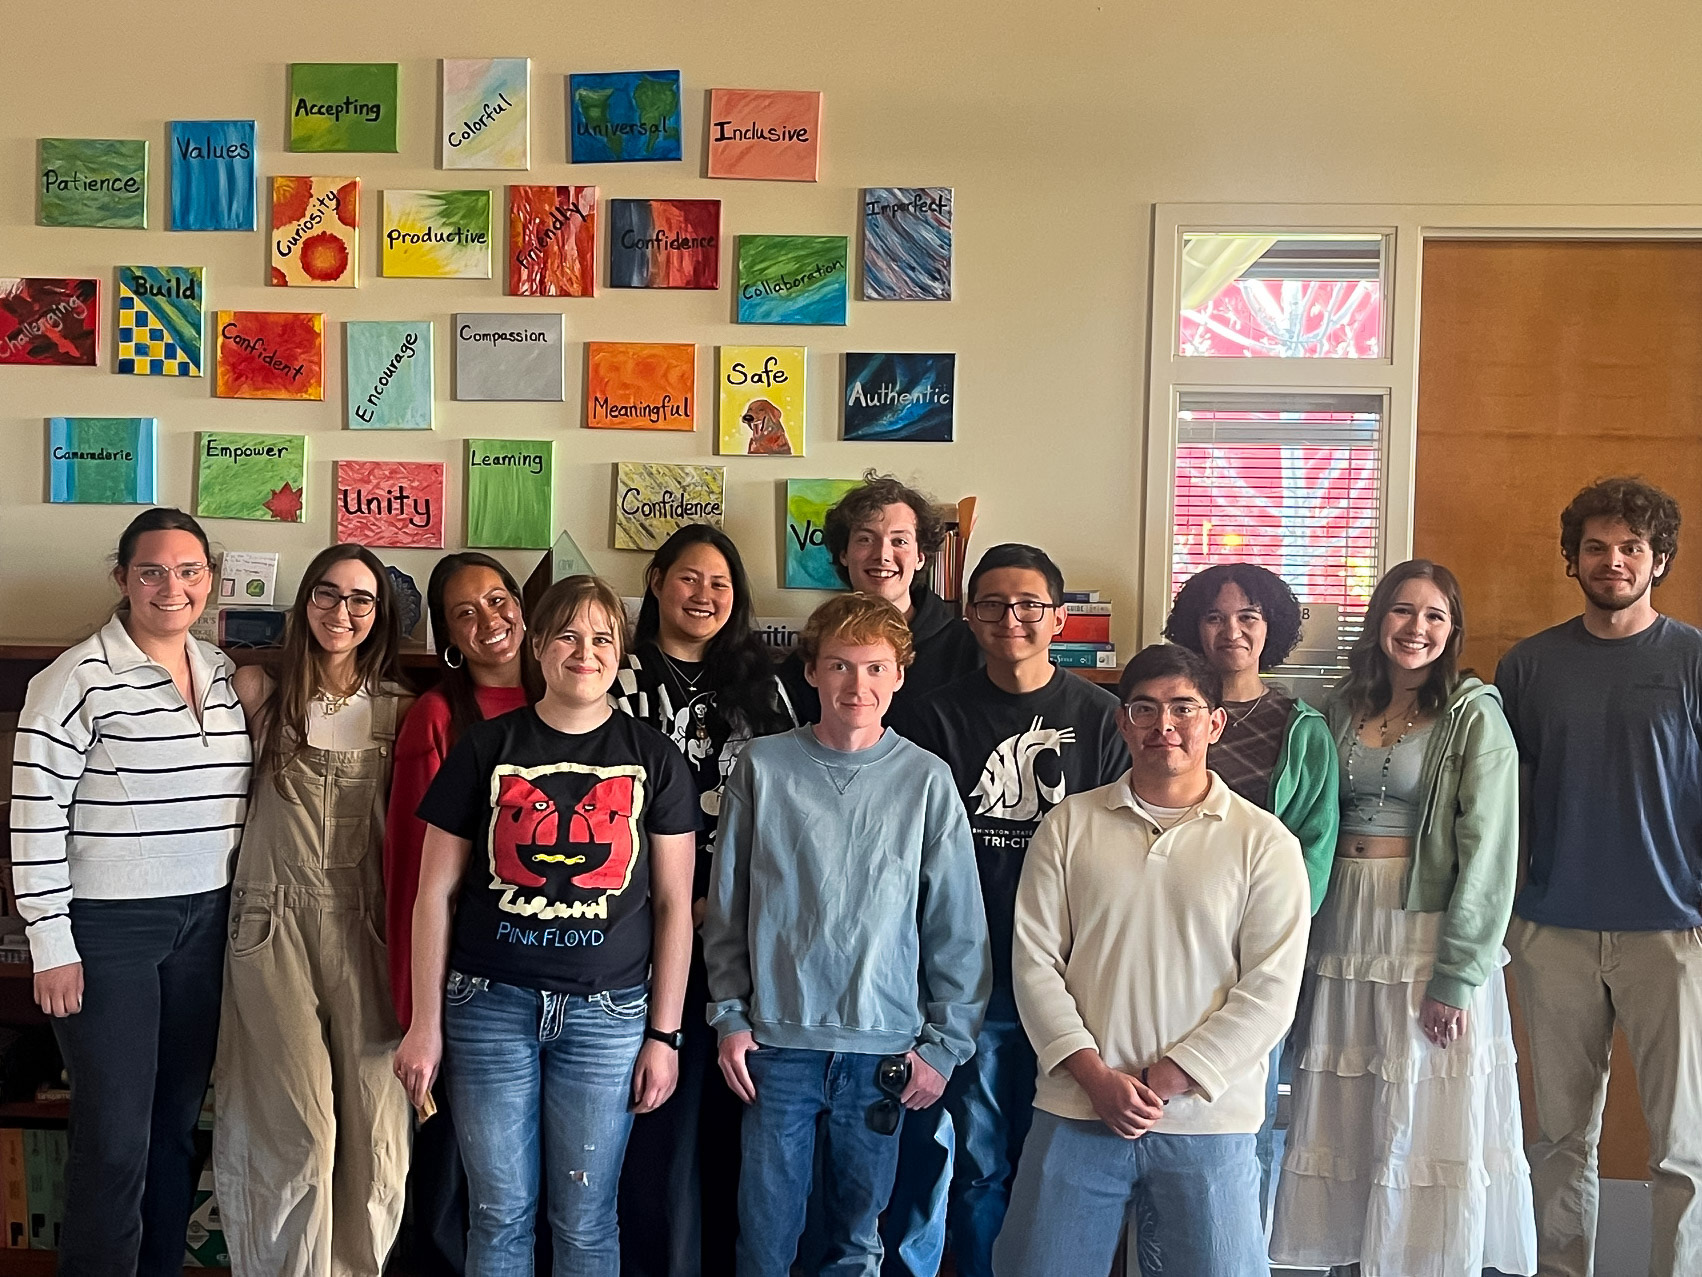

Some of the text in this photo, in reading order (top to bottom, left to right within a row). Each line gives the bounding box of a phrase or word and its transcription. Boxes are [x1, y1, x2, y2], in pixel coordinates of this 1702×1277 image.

[294, 96, 381, 122] Accepting
[448, 92, 513, 148] Colorful
[576, 116, 668, 137] Universal
[713, 120, 810, 143] Inclusive
[176, 136, 251, 161] Values
[43, 169, 141, 195] Patience
[866, 193, 948, 218] Imperfect
[276, 188, 341, 258] Curiosity
[515, 201, 587, 270] Friendly
[620, 229, 715, 250] Confidence
[131, 275, 196, 300] Build
[742, 259, 844, 300] Collaboration
[459, 324, 548, 347] Compassion
[221, 322, 304, 381] Confident
[355, 332, 418, 423] Encourage
[727, 356, 789, 388] Safe
[848, 381, 950, 407] Authentic
[592, 395, 690, 423] Meaningful
[53, 446, 133, 461] Camaraderie
[206, 438, 289, 464] Empower
[471, 450, 543, 474] Learning
[342, 485, 431, 528] Unity
[620, 487, 723, 520] Confidence
[496, 921, 605, 947] PINK FLOYD
